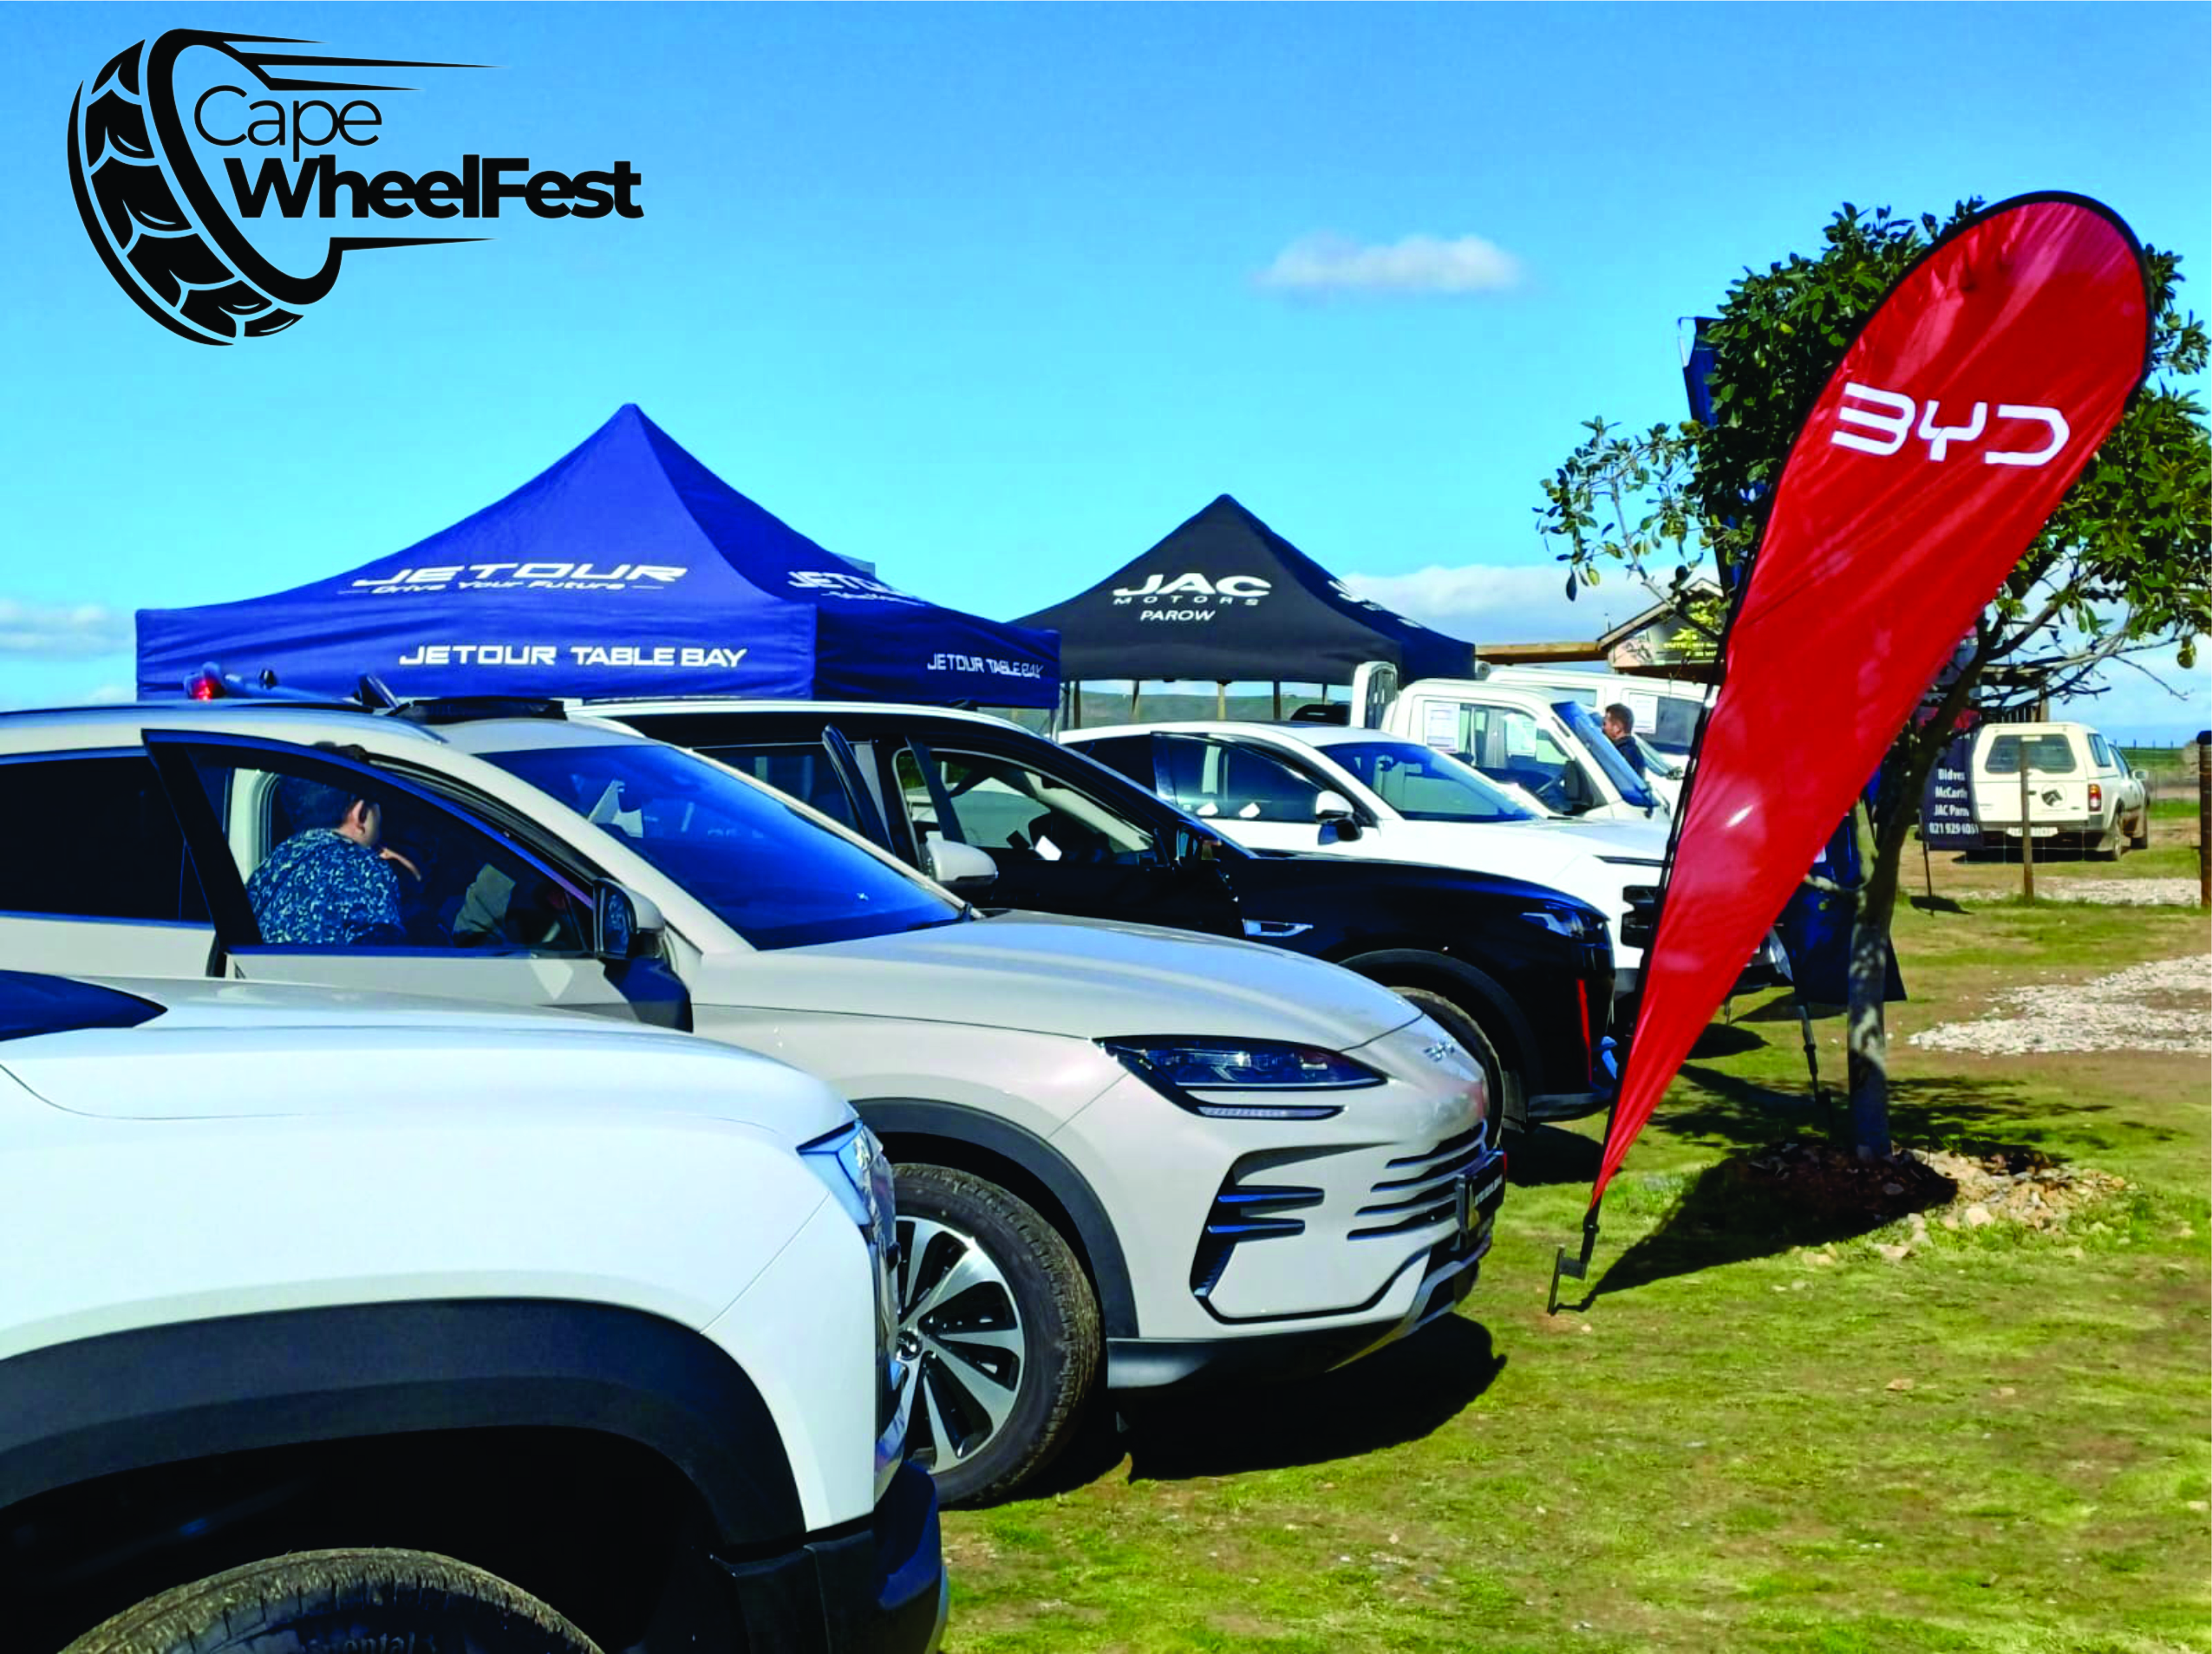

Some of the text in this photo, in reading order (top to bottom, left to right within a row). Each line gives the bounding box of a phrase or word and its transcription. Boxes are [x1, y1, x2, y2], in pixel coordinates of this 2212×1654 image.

[1830, 381, 2070, 466] BYD
[352, 563, 688, 587] JETOUR
[371, 583, 447, 594] Drive
[527, 580, 625, 590] Future
[1113, 572, 1272, 597] JAC
[1113, 596, 1259, 606] MOTORS
[1140, 609, 1216, 622] PAROW
[399, 645, 747, 668] JETOUR TABLE BAY
[927, 653, 985, 673] JETOUR
[986, 658, 1021, 677] TABLE
[1934, 804, 1948, 816] JAC
[1929, 823, 1943, 834] 021
